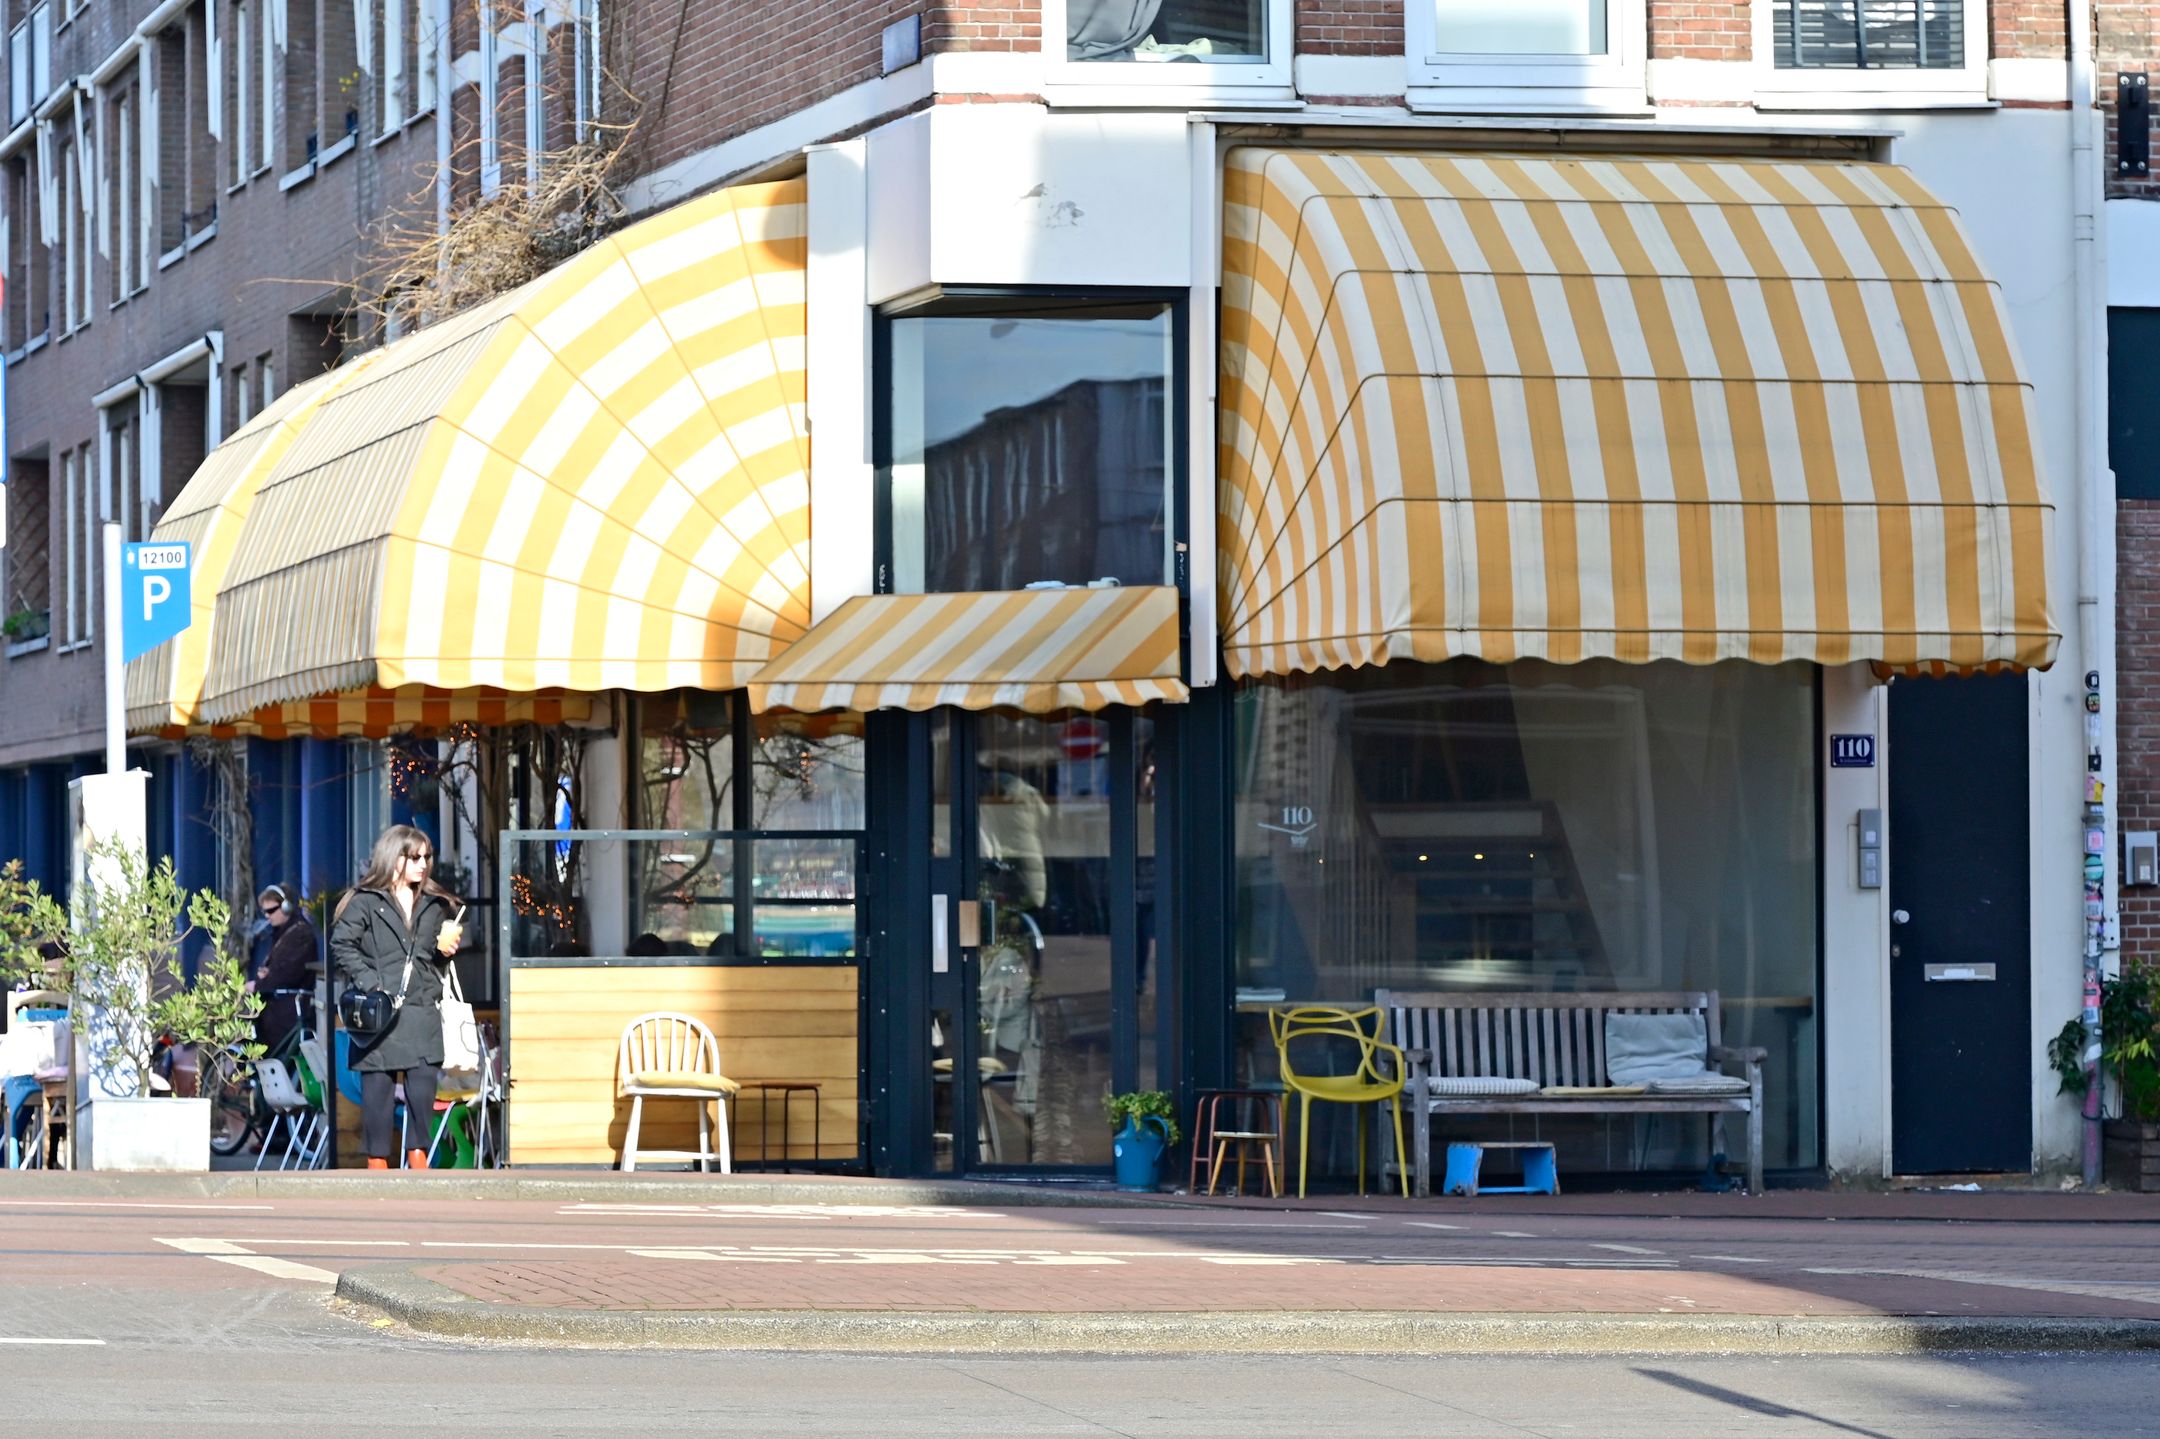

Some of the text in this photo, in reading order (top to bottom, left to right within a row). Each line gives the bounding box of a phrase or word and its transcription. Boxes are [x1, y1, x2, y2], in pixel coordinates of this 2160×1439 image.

[144, 551, 182, 564] 12100
[143, 575, 171, 621] P
[1838, 738, 1871, 757] 110
[1283, 806, 1312, 825] 110
